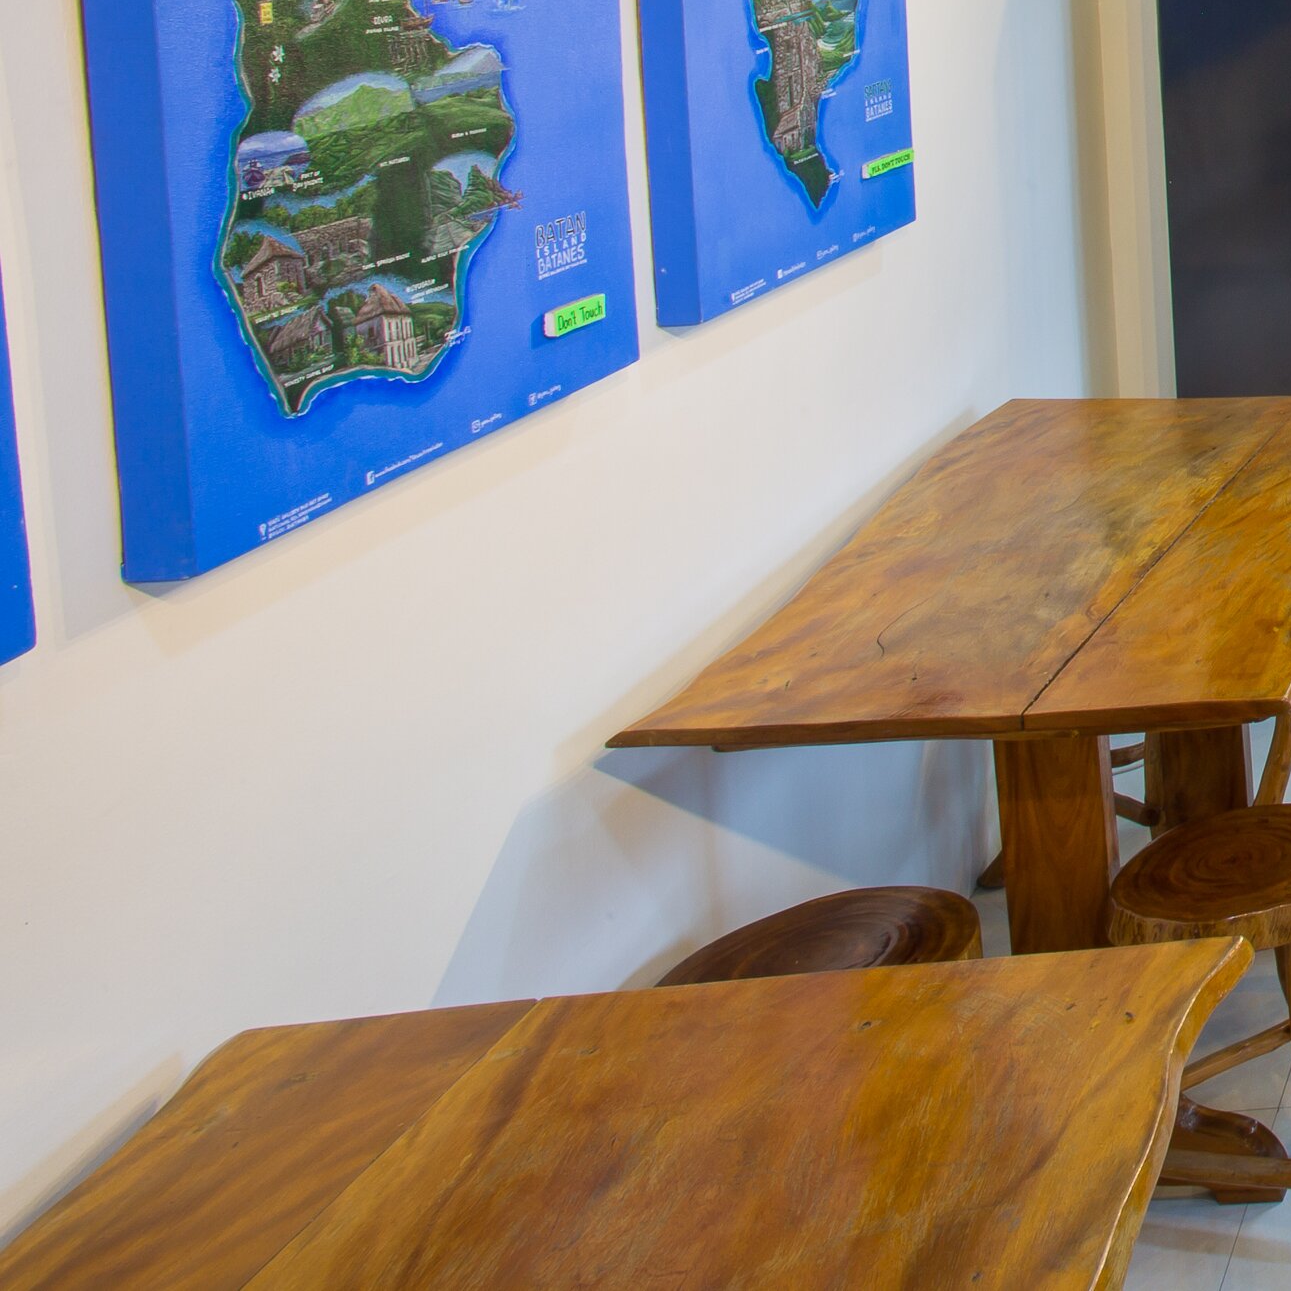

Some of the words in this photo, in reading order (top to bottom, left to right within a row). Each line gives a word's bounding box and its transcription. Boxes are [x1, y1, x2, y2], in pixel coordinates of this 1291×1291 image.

[536, 211, 586, 248] BATAN
[536, 232, 587, 258] ISLAND
[538, 244, 585, 274] BATANES
[557, 312, 577, 331] Don't
[579, 301, 603, 323] Touch
